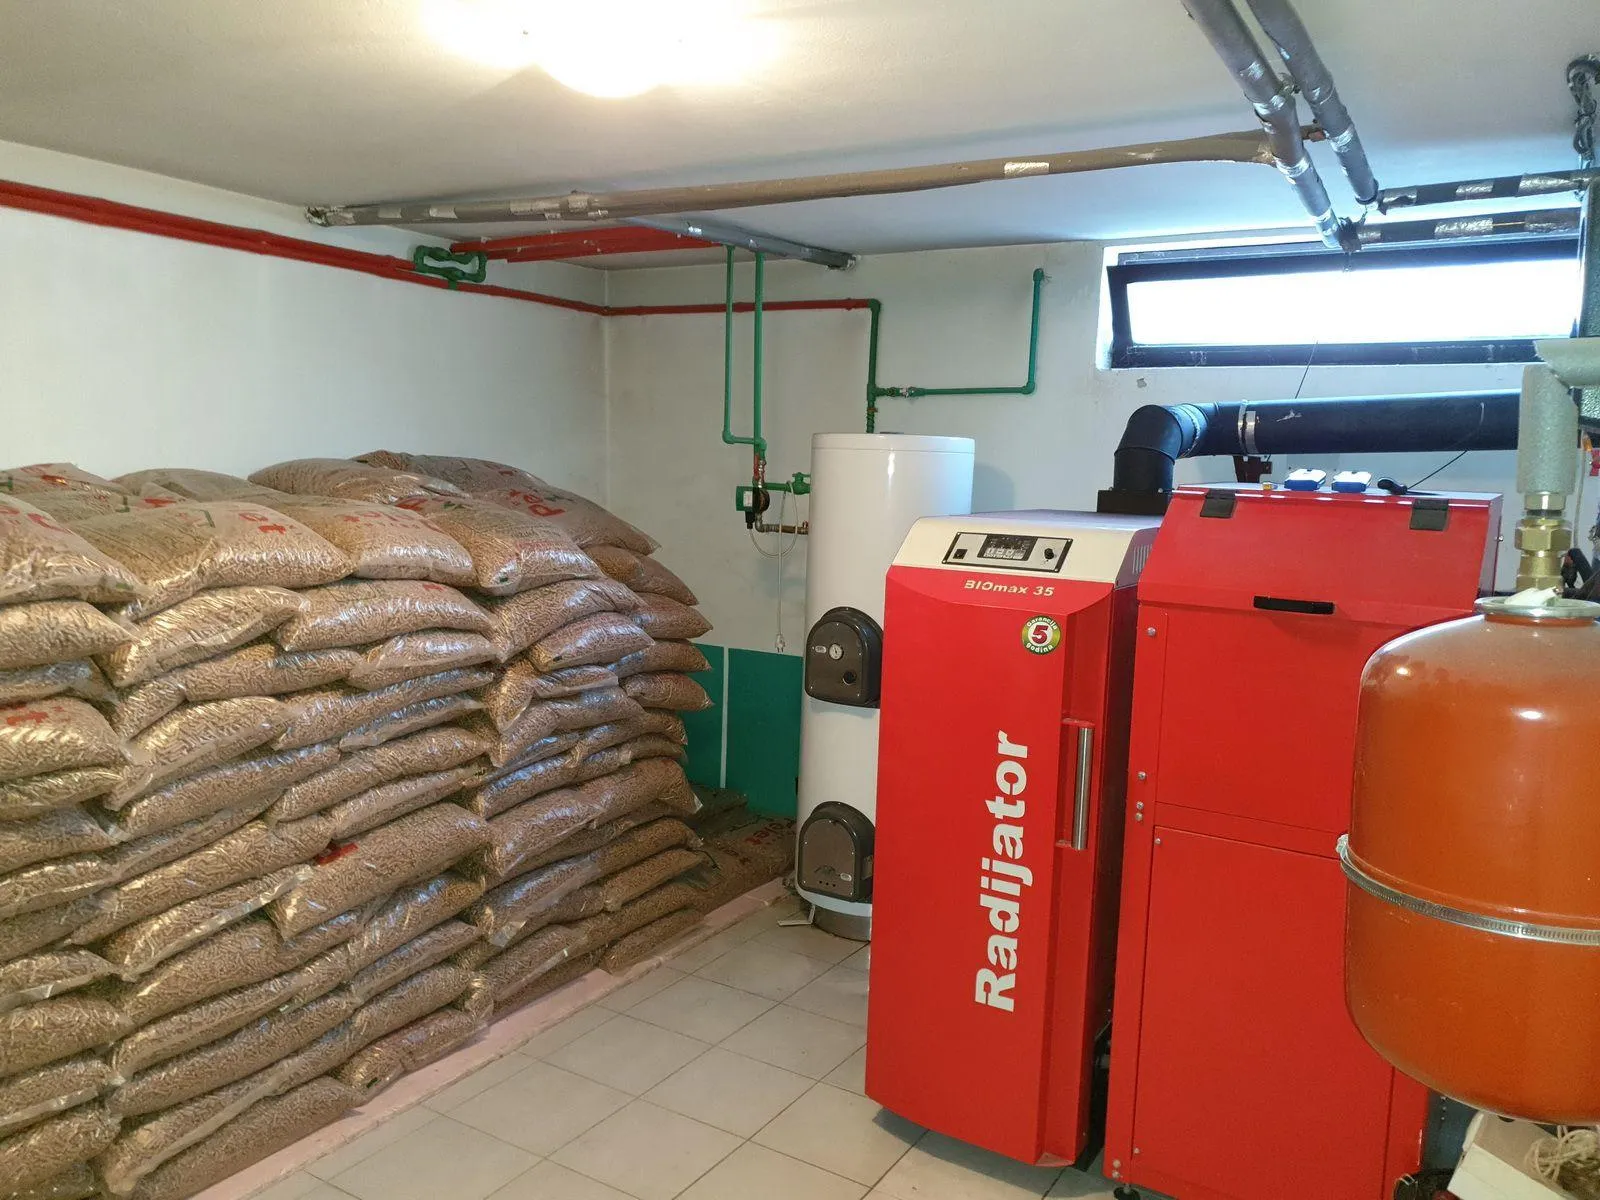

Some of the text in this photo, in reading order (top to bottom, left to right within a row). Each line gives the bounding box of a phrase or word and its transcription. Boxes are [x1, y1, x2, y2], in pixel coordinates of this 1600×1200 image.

[964, 580, 1054, 596] BIOmax 35
[1031, 625, 1049, 644] 5
[974, 729, 1033, 1012] Radijator
